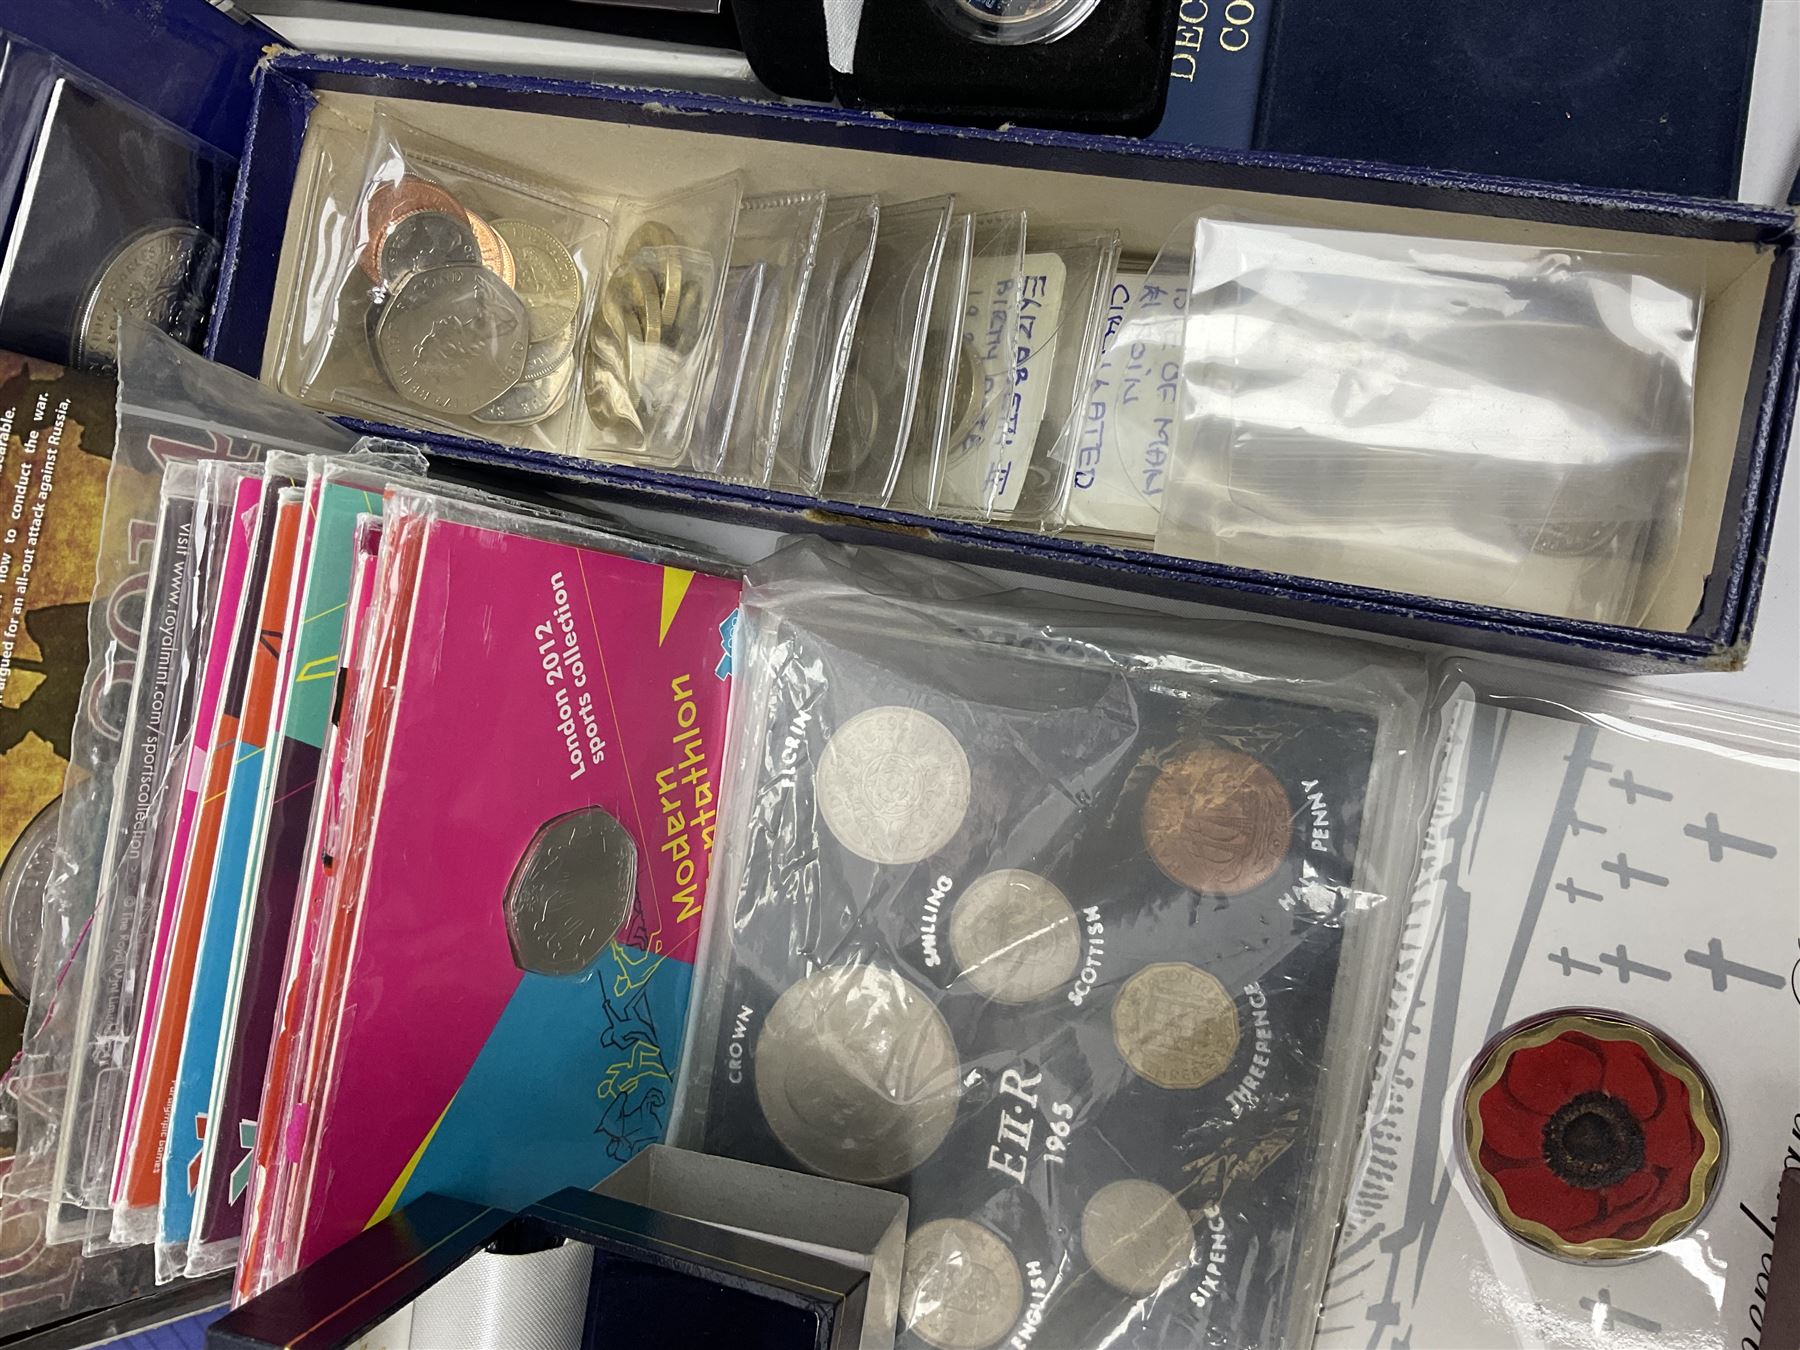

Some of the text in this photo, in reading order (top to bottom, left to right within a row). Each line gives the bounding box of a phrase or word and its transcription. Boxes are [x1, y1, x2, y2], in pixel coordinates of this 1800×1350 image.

[1157, 362, 1180, 402] OF
[48, 398, 72, 446] Russia,
[1142, 417, 1174, 496] MAN
[4, 528, 17, 544] to
[11, 462, 32, 520] conduct
[24, 430, 40, 454] the
[33, 392, 49, 422] war.
[38, 447, 58, 500] against
[28, 502, 46, 546] attack
[175, 523, 191, 557] visit
[15, 548, 36, 594] all-out
[4, 618, 19, 638] for
[12, 597, 24, 615] an
[534, 620, 586, 781] London 2012
[550, 571, 606, 765] sports collection
[655, 766, 702, 924] Modern
[1301, 779, 1330, 852] PENNY
[1067, 905, 1105, 1007] SCOTTISH
[727, 1004, 754, 1084] CROWN
[1042, 1100, 1074, 1165] 1965
[1189, 1203, 1228, 1308] SIXPENCE
